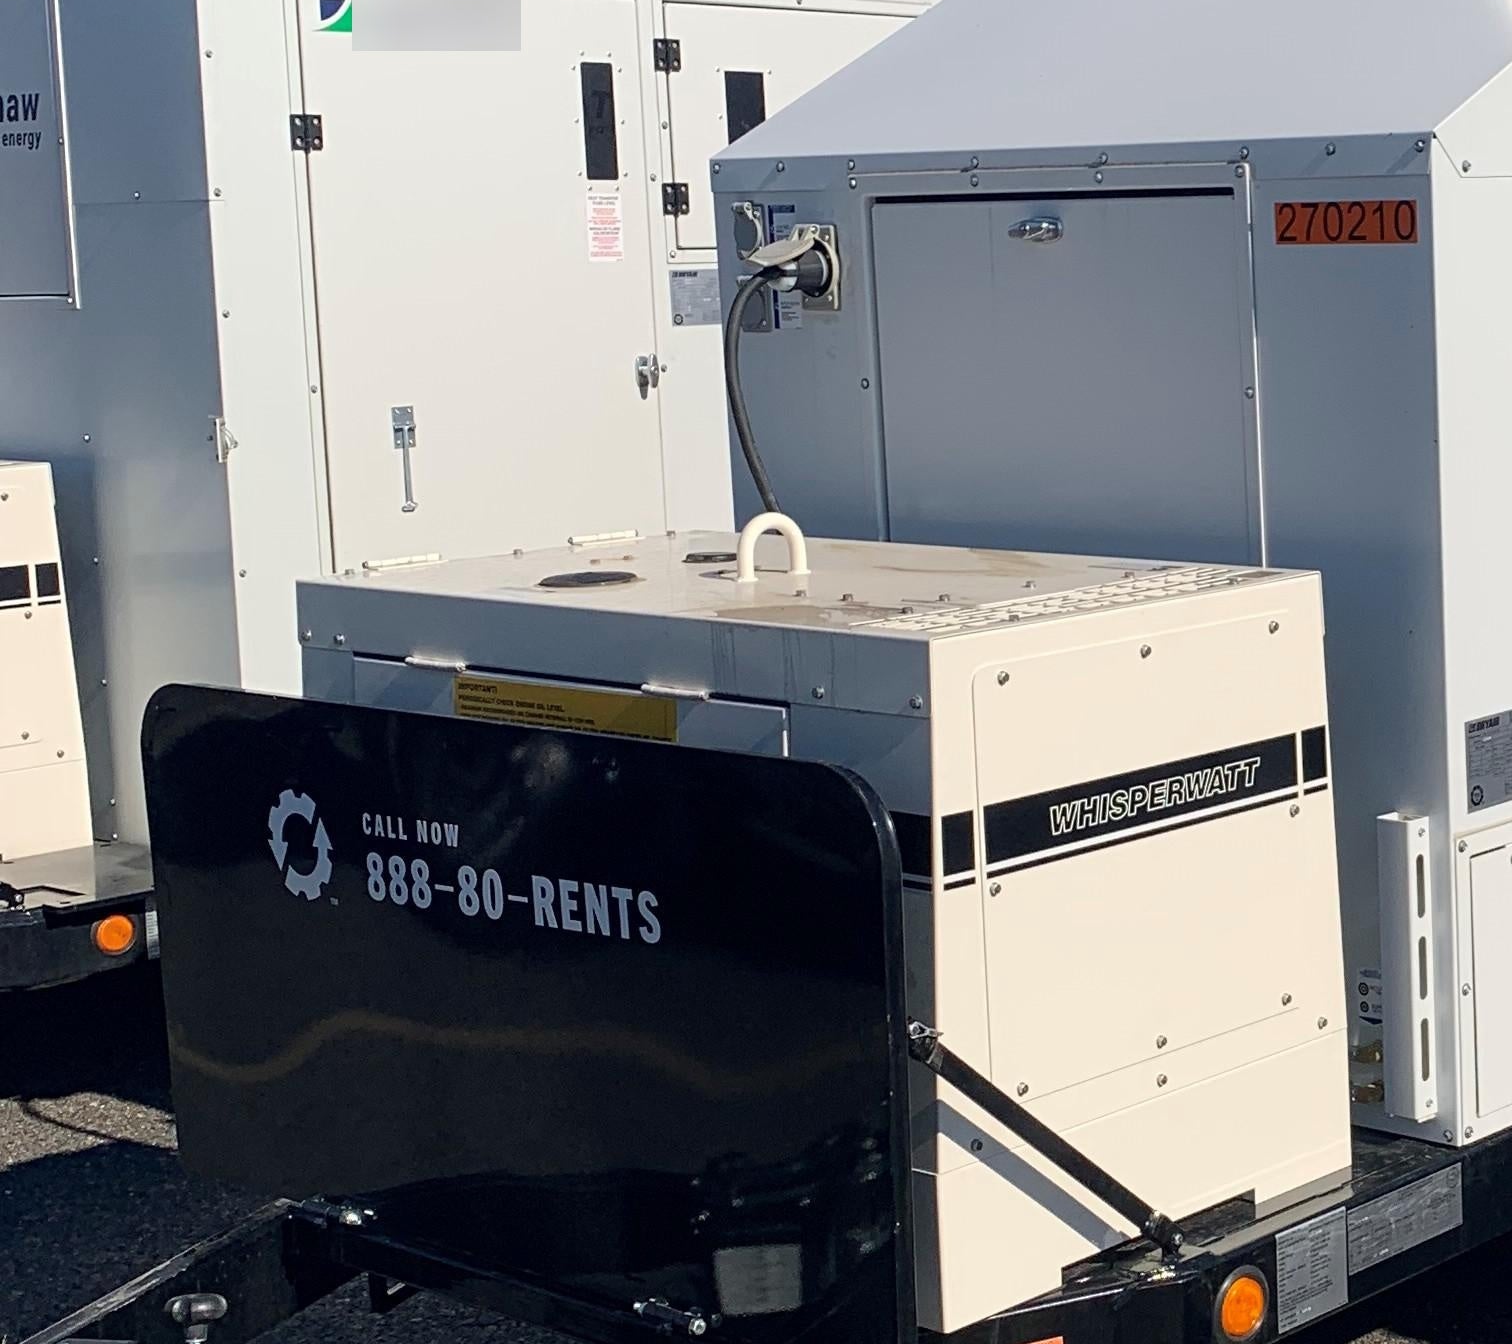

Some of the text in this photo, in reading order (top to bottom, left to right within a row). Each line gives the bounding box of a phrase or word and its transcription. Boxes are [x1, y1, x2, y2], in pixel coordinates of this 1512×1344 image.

[2, 131, 42, 150] energy
[1278, 200, 1416, 242] 270210
[1049, 756, 1261, 836] WHISPERWATT
[361, 812, 460, 848] CALL NOW
[366, 852, 662, 944] 888-80-RENTS
